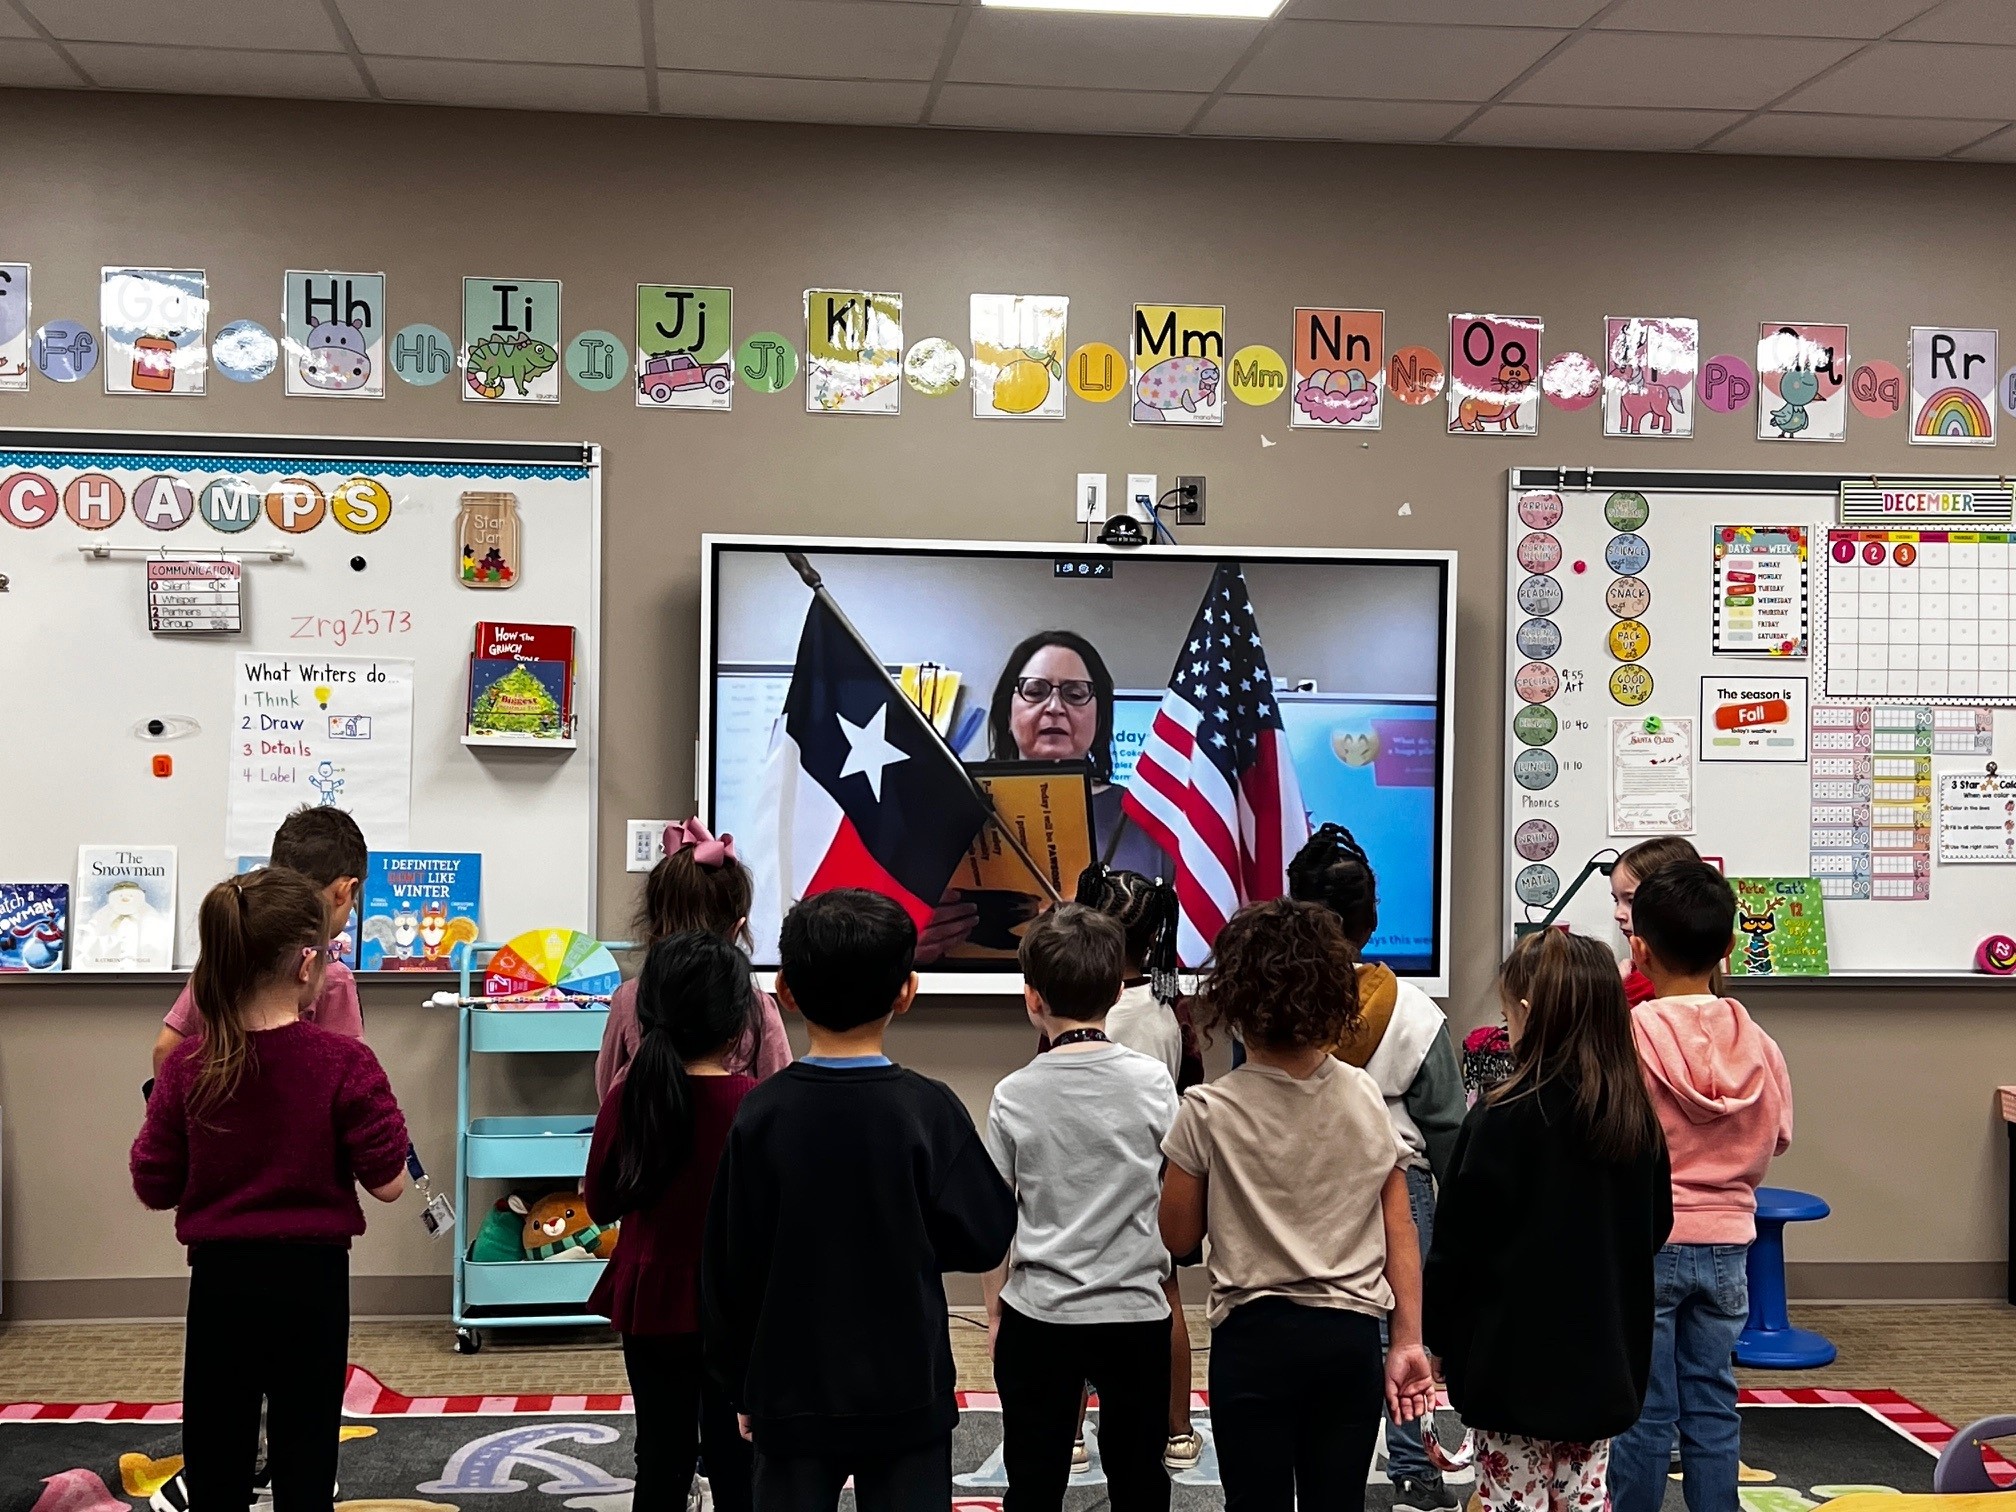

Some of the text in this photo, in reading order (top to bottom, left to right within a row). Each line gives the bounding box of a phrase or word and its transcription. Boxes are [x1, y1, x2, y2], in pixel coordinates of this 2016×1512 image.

[305, 279, 371, 327] Hh
[492, 285, 533, 332] Ii
[656, 292, 705, 351] Jj
[1136, 310, 1223, 357] Mm
[1310, 314, 1370, 362] Nn
[1463, 321, 1527, 367] Oo
[39, 331, 93, 371] Ff
[397, 333, 450, 374] Hh
[1931, 334, 1986, 380] Rr
[578, 339, 614, 379] Ii
[744, 341, 785, 389] Jj
[1079, 353, 1113, 391] Ll
[1233, 359, 1283, 388] Mm
[1705, 363, 1751, 410] Pp
[1851, 366, 1899, 411] Qq
[1883, 493, 1973, 512] DECEMBER
[474, 514, 505, 529] Star
[475, 530, 502, 544] Jar
[1608, 545, 1646, 555] SCIENCE
[1728, 543, 1751, 553] DAYS
[1769, 543, 1792, 553] WEEK
[1842, 545, 1847, 558] 1
[1870, 547, 1878, 560] 2
[1901, 548, 1909, 561] 3
[152, 565, 235, 576] COMMUNICATION
[151, 581, 159, 591] 0
[153, 594, 157, 605] 1
[1520, 589, 1560, 598] READING
[1609, 588, 1646, 598] SNACK
[152, 607, 159, 618] 2
[153, 618, 194, 630] 3 Group
[1617, 631, 1641, 641] PACK
[489, 643, 522, 656] GRINCH
[1622, 641, 1635, 650] UP
[245, 662, 356, 683] What Writers
[1517, 675, 1558, 688] SPECIALS
[1564, 680, 1585, 693] Art
[1617, 675, 1646, 685] GOOD
[1622, 684, 1641, 694] BYE
[1717, 688, 1792, 700] The season is
[254, 689, 300, 709] Think
[1738, 705, 1765, 723] Fall
[1856, 710, 1870, 724] 10
[1916, 712, 1933, 724] 90
[260, 714, 305, 731] Draw
[1854, 734, 1871, 748] 20
[1915, 737, 1932, 747] 100
[261, 740, 312, 757] Details
[1519, 761, 1551, 772] LUNCH
[1853, 760, 1871, 774] 30
[260, 766, 296, 783] Label
[1853, 783, 1871, 797] 40
[1951, 780, 1980, 789] 3 Star
[1521, 795, 1560, 809] Phonics
[1853, 808, 1870, 821] 50
[1852, 832, 1869, 844] 60
[115, 852, 144, 864] The
[1852, 857, 1869, 870] 70
[92, 861, 165, 876] Snowman
[383, 859, 461, 871] I DEFINITELY
[428, 872, 456, 884] LIKE
[1521, 874, 1552, 889] MATH
[393, 885, 451, 898] WINTER
[1738, 881, 1806, 895] Pete Cat's
[1852, 881, 1870, 894] 80
